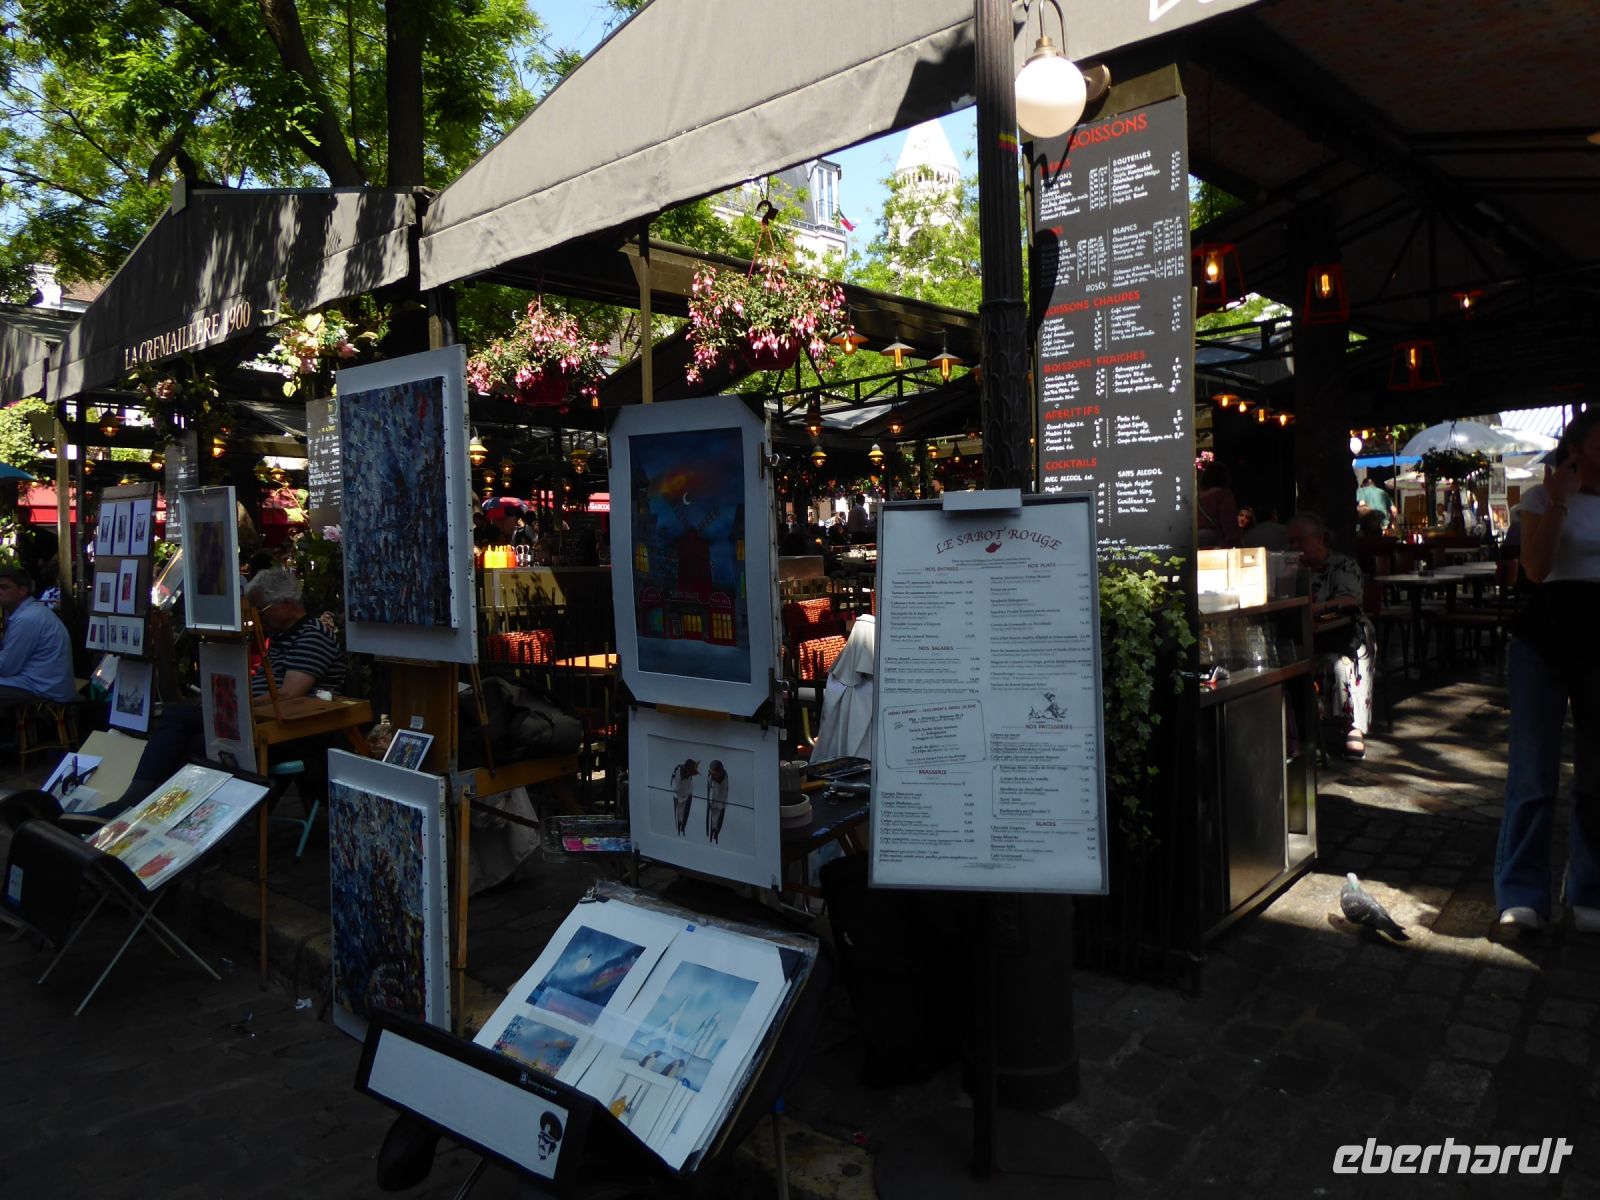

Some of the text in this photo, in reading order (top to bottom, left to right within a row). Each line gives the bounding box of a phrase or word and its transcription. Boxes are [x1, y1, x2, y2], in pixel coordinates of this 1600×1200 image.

[1112, 150, 1152, 168] BOUTEILLES
[1112, 223, 1139, 237] BLANCS
[1092, 289, 1142, 310] CHAUDES
[125, 347, 138, 371] LA
[222, 300, 252, 336] 1900
[1043, 356, 1092, 375] BOISSONS
[1044, 457, 1098, 471] COCKTAILS
[1117, 468, 1163, 478] SANS ALCOOL
[1060, 474, 1083, 482] ALCOOL
[936, 538, 954, 555] LE
[1007, 528, 1063, 551] ROUGE
